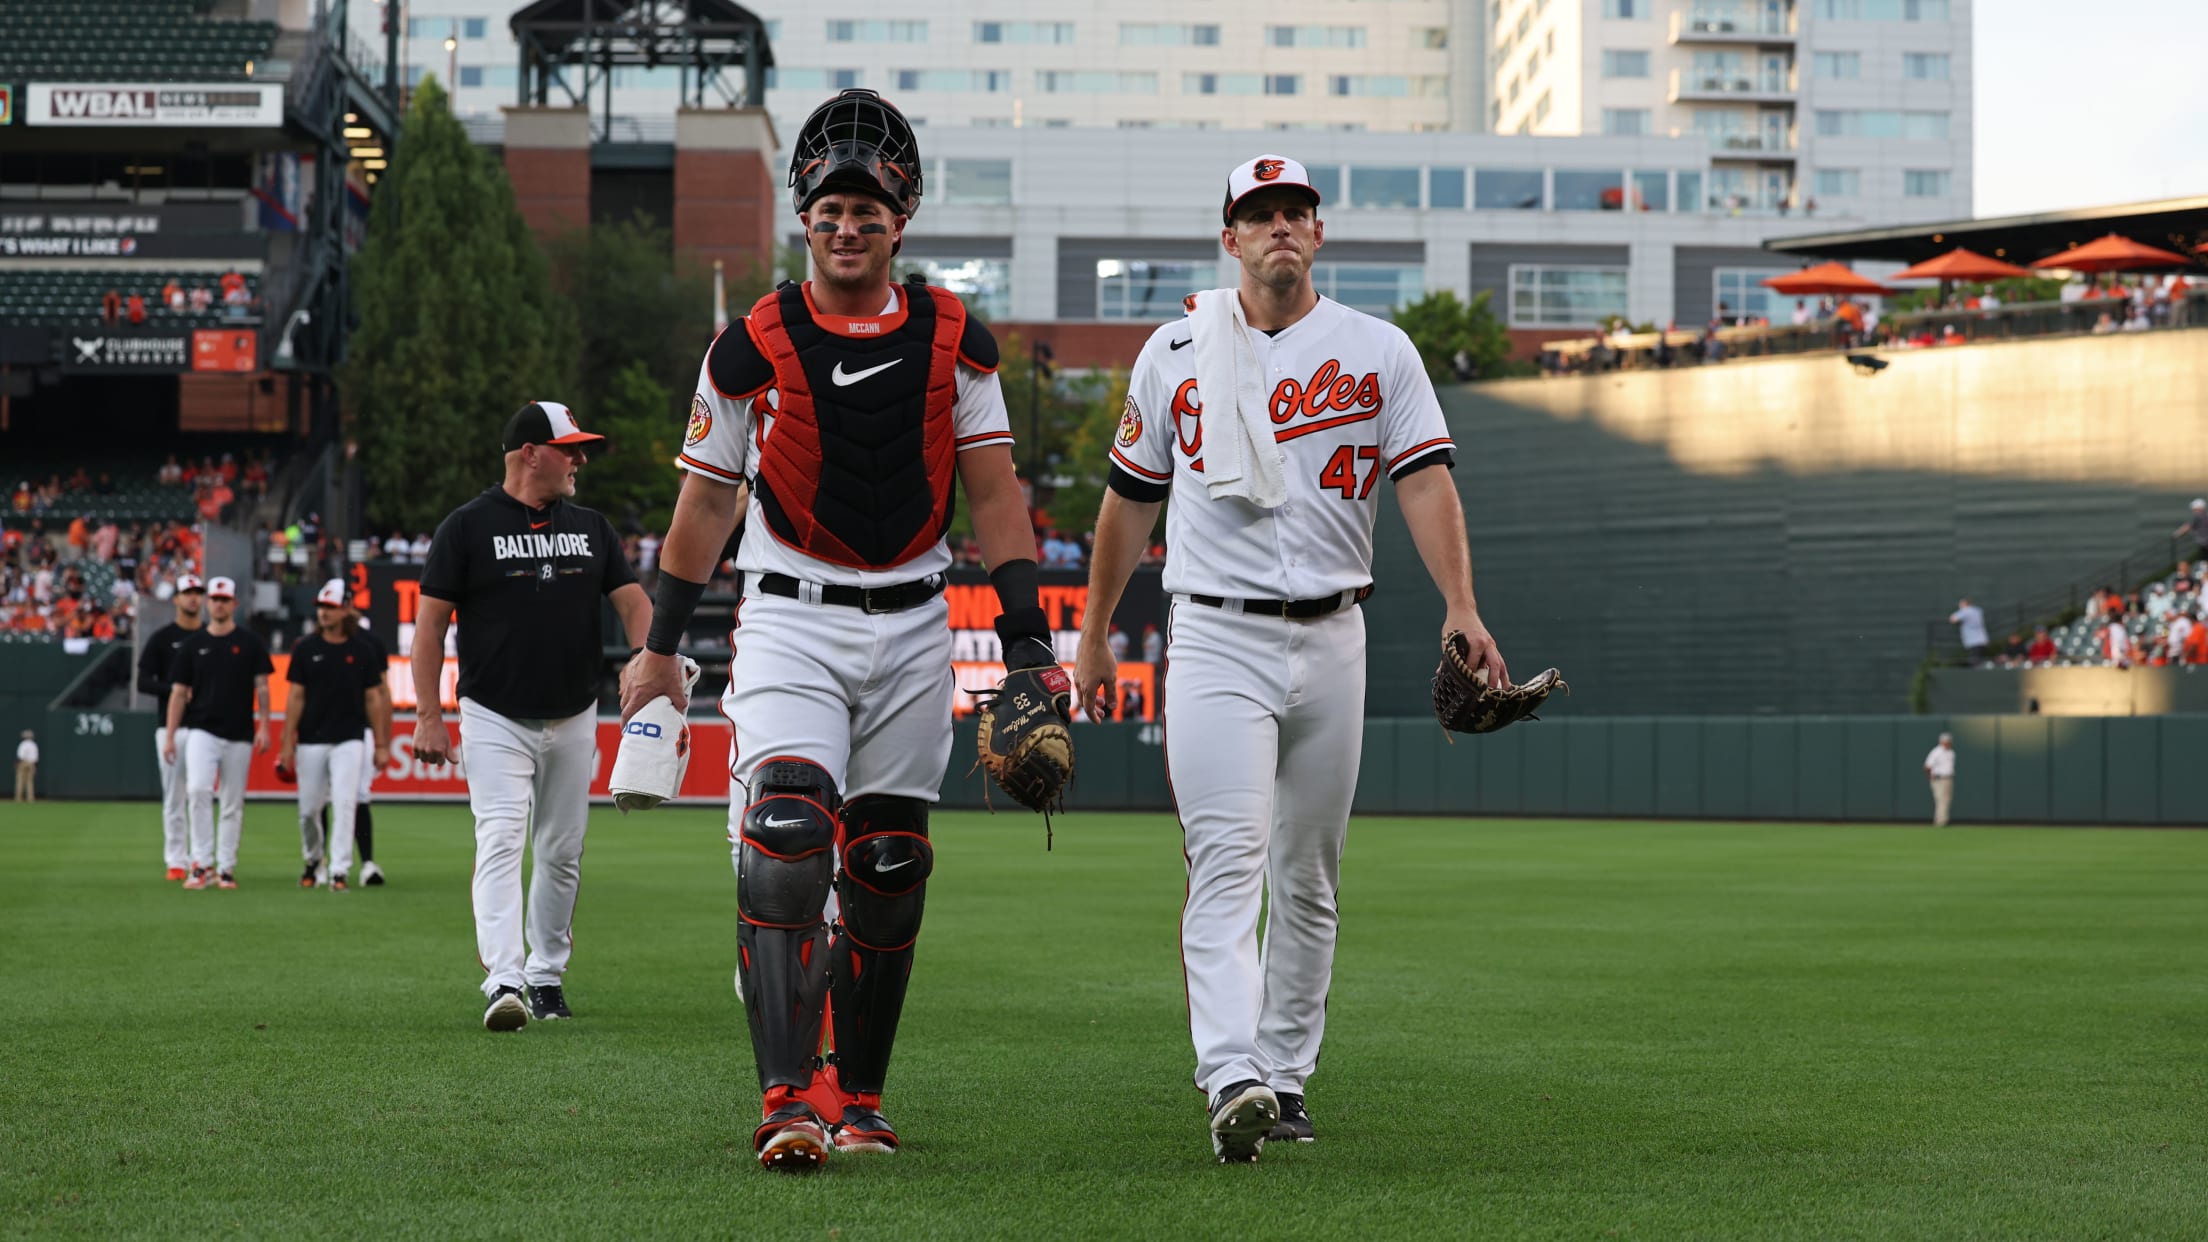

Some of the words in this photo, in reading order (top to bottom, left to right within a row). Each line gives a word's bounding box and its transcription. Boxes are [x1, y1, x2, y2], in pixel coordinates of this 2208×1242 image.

[53, 92, 150, 117] WBAL
[19, 238, 70, 254] WHAT
[72, 238, 79, 254] I
[82, 238, 119, 254] LIKE
[848, 322, 880, 334] MCCANN
[105, 337, 186, 351] CLUBHOUSE
[1171, 359, 1382, 457] Ooles
[1320, 445, 1379, 500] 47
[493, 533, 593, 560] BALTIMORE
[542, 564, 552, 580] B
[1013, 692, 1031, 711] 33
[74, 713, 114, 736] 376
